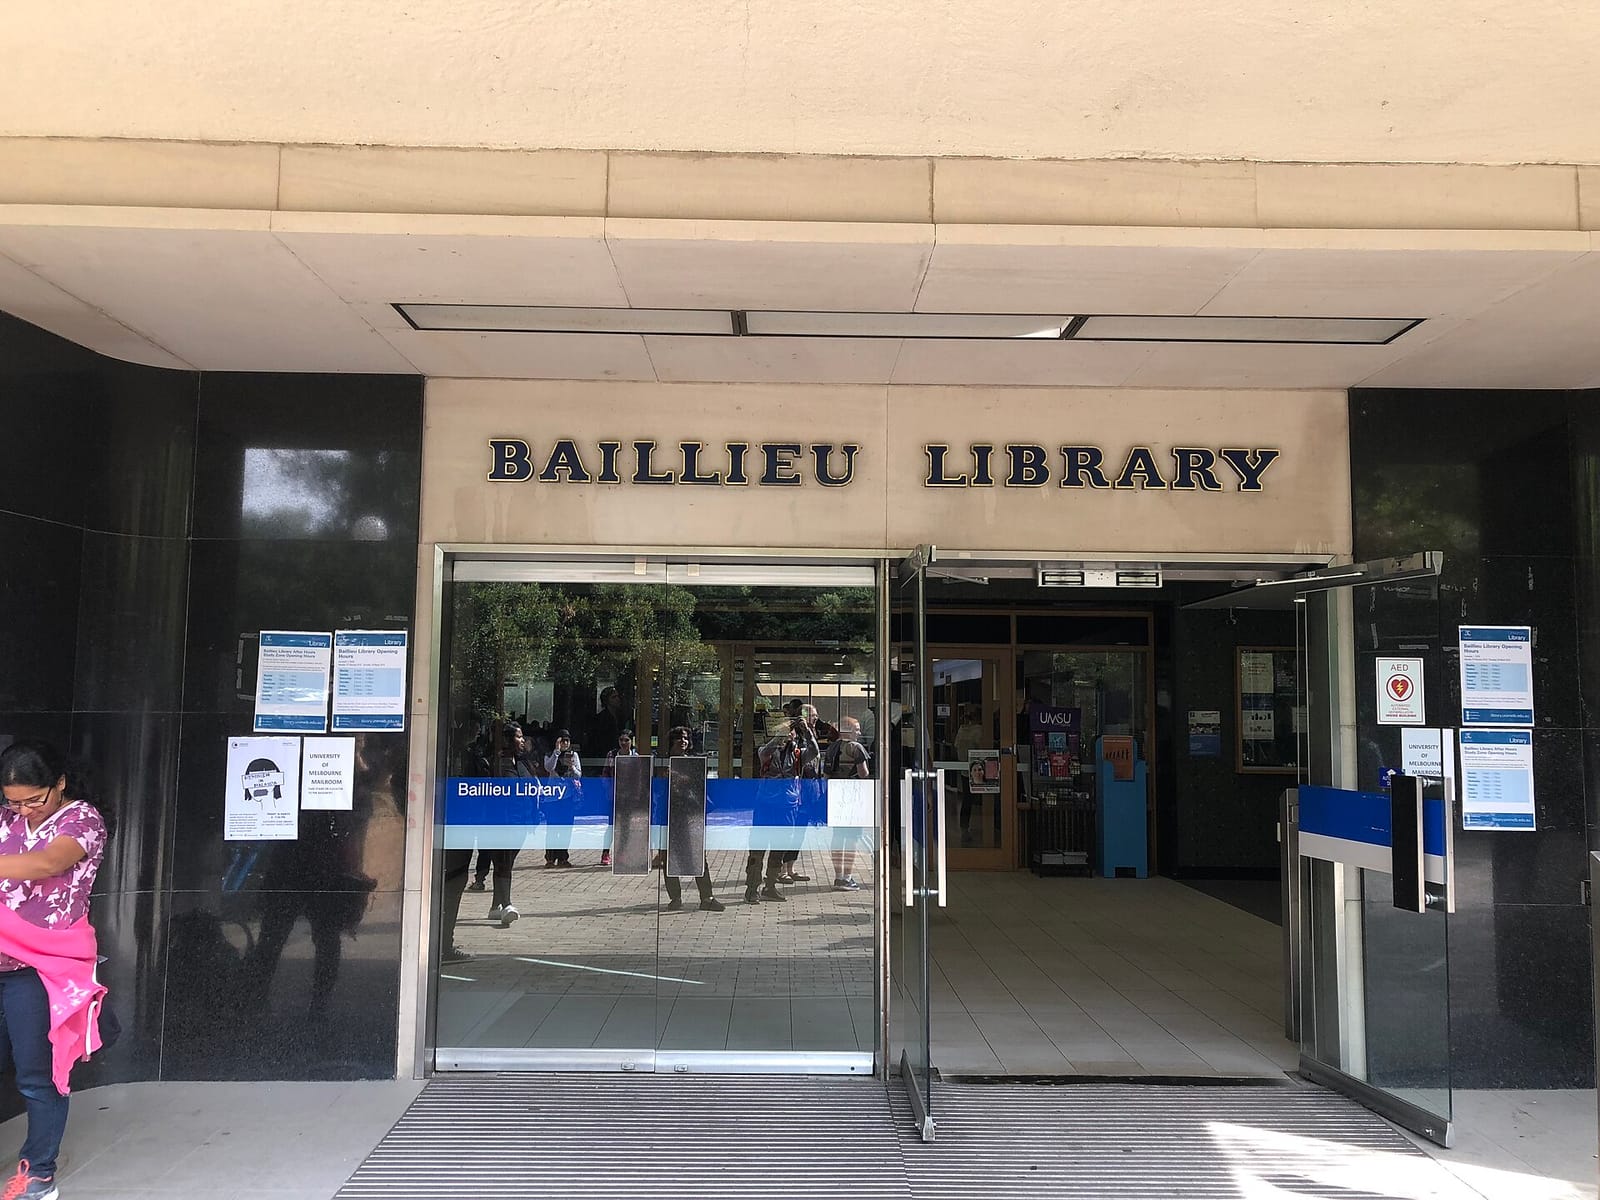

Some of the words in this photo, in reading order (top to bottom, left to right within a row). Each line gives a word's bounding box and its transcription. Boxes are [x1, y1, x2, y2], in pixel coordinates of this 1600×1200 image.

[486, 438, 861, 487] BAILLIEU
[924, 443, 1281, 492] LIBRARY
[308, 640, 327, 648] Library
[1390, 664, 1409, 672] AED
[1040, 711, 1072, 725] UMSU
[458, 782, 511, 796] Baillieu
[516, 782, 567, 800] Library
